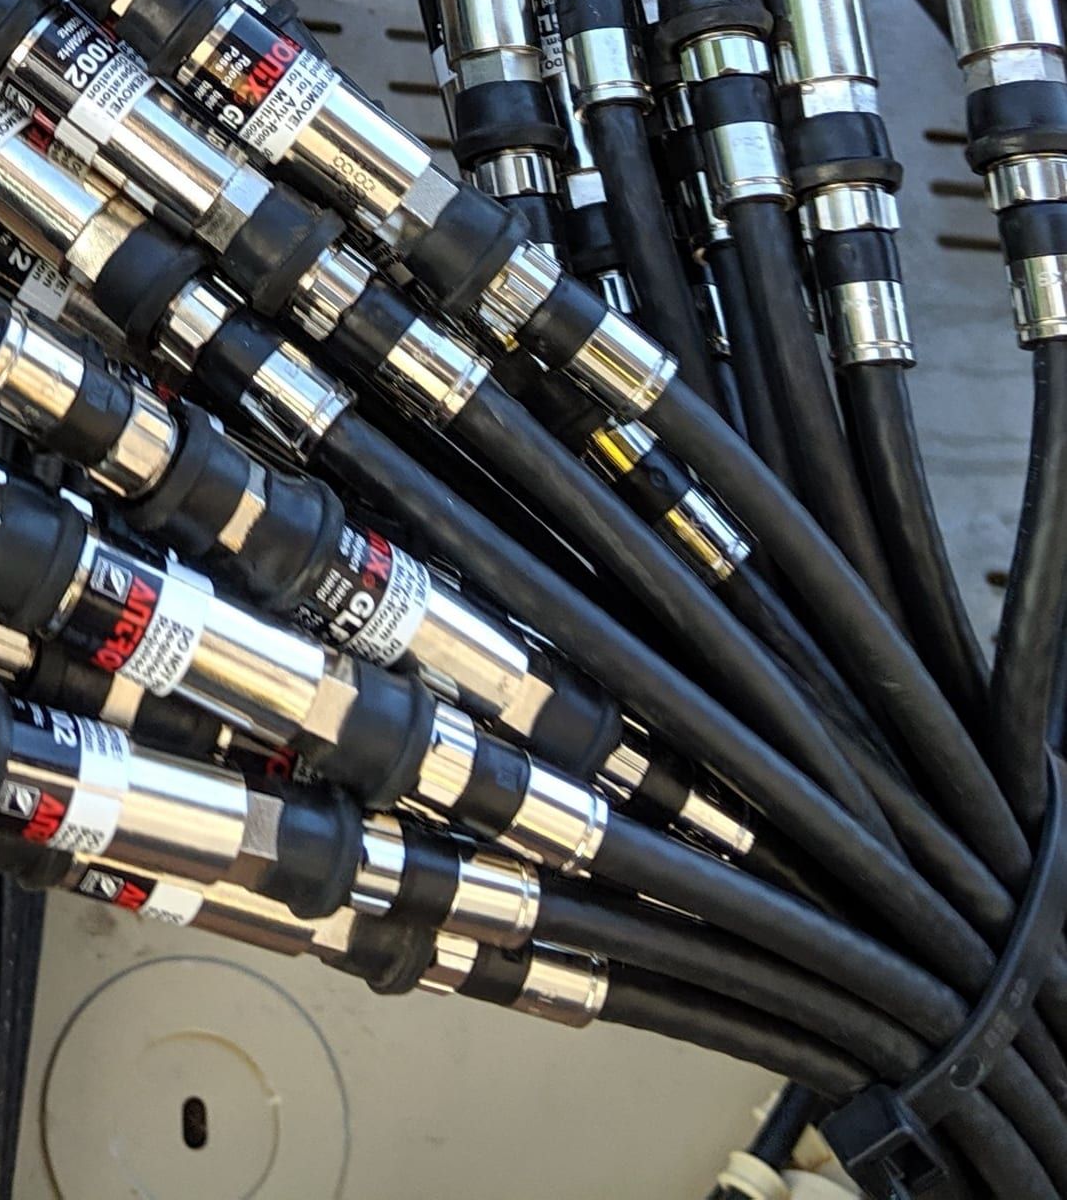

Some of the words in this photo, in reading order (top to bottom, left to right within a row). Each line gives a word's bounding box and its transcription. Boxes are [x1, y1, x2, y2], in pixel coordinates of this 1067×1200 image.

[61, 34, 116, 90] 1002
[212, 43, 241, 75] Pass
[284, 68, 303, 88] for
[294, 77, 313, 96] for
[286, 77, 329, 128] REMOVE
[313, 566, 343, 602] band
[323, 576, 355, 612] band
